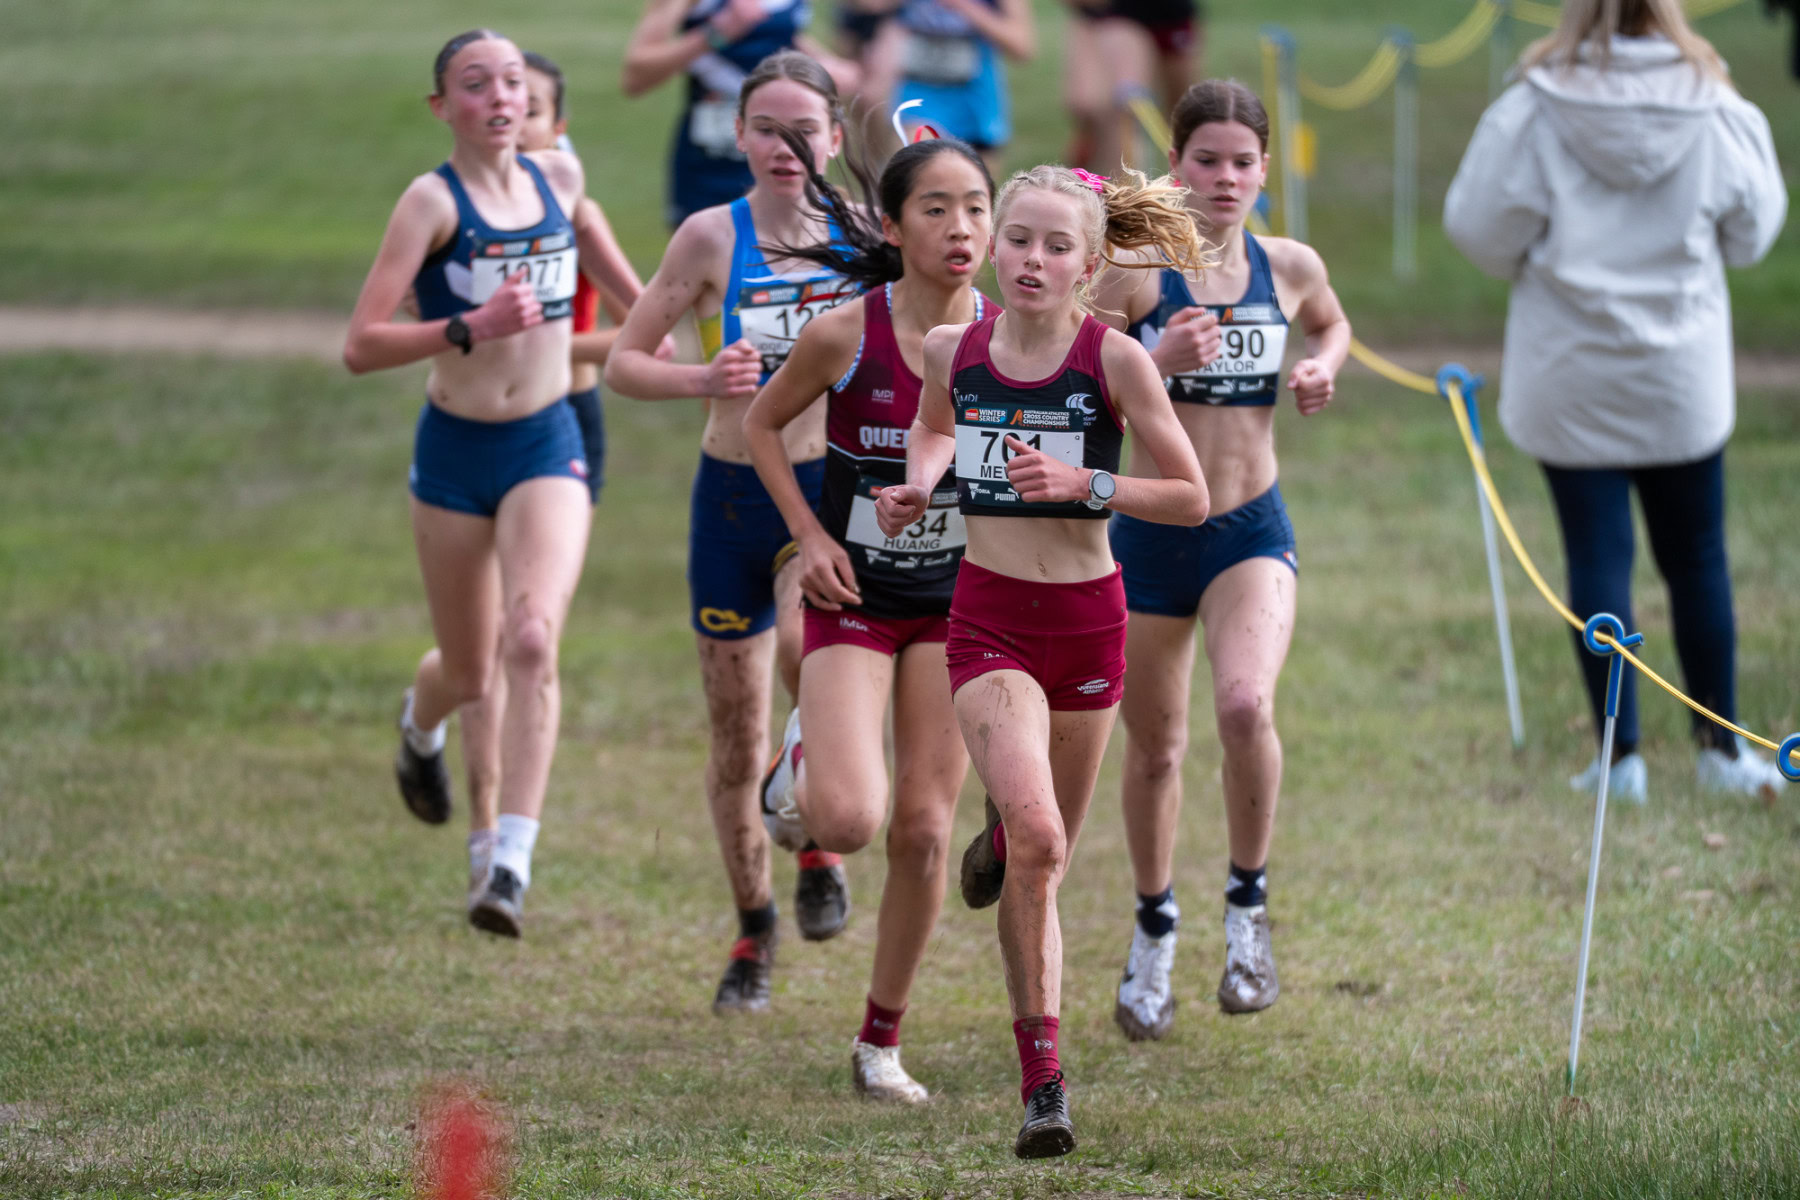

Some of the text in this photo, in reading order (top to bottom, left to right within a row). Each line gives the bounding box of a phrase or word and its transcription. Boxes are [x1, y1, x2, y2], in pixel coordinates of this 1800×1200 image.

[497, 257, 562, 285] 1077
[776, 304, 836, 337] 12
[1219, 329, 1264, 359] 90
[979, 409, 1006, 417] WINTER
[979, 415, 1001, 423] SERIES
[980, 430, 1041, 464] 701
[980, 465, 1009, 479] ME
[995, 493, 1016, 501] PUMA
[906, 511, 948, 538] 34
[883, 538, 941, 550] HUANG
